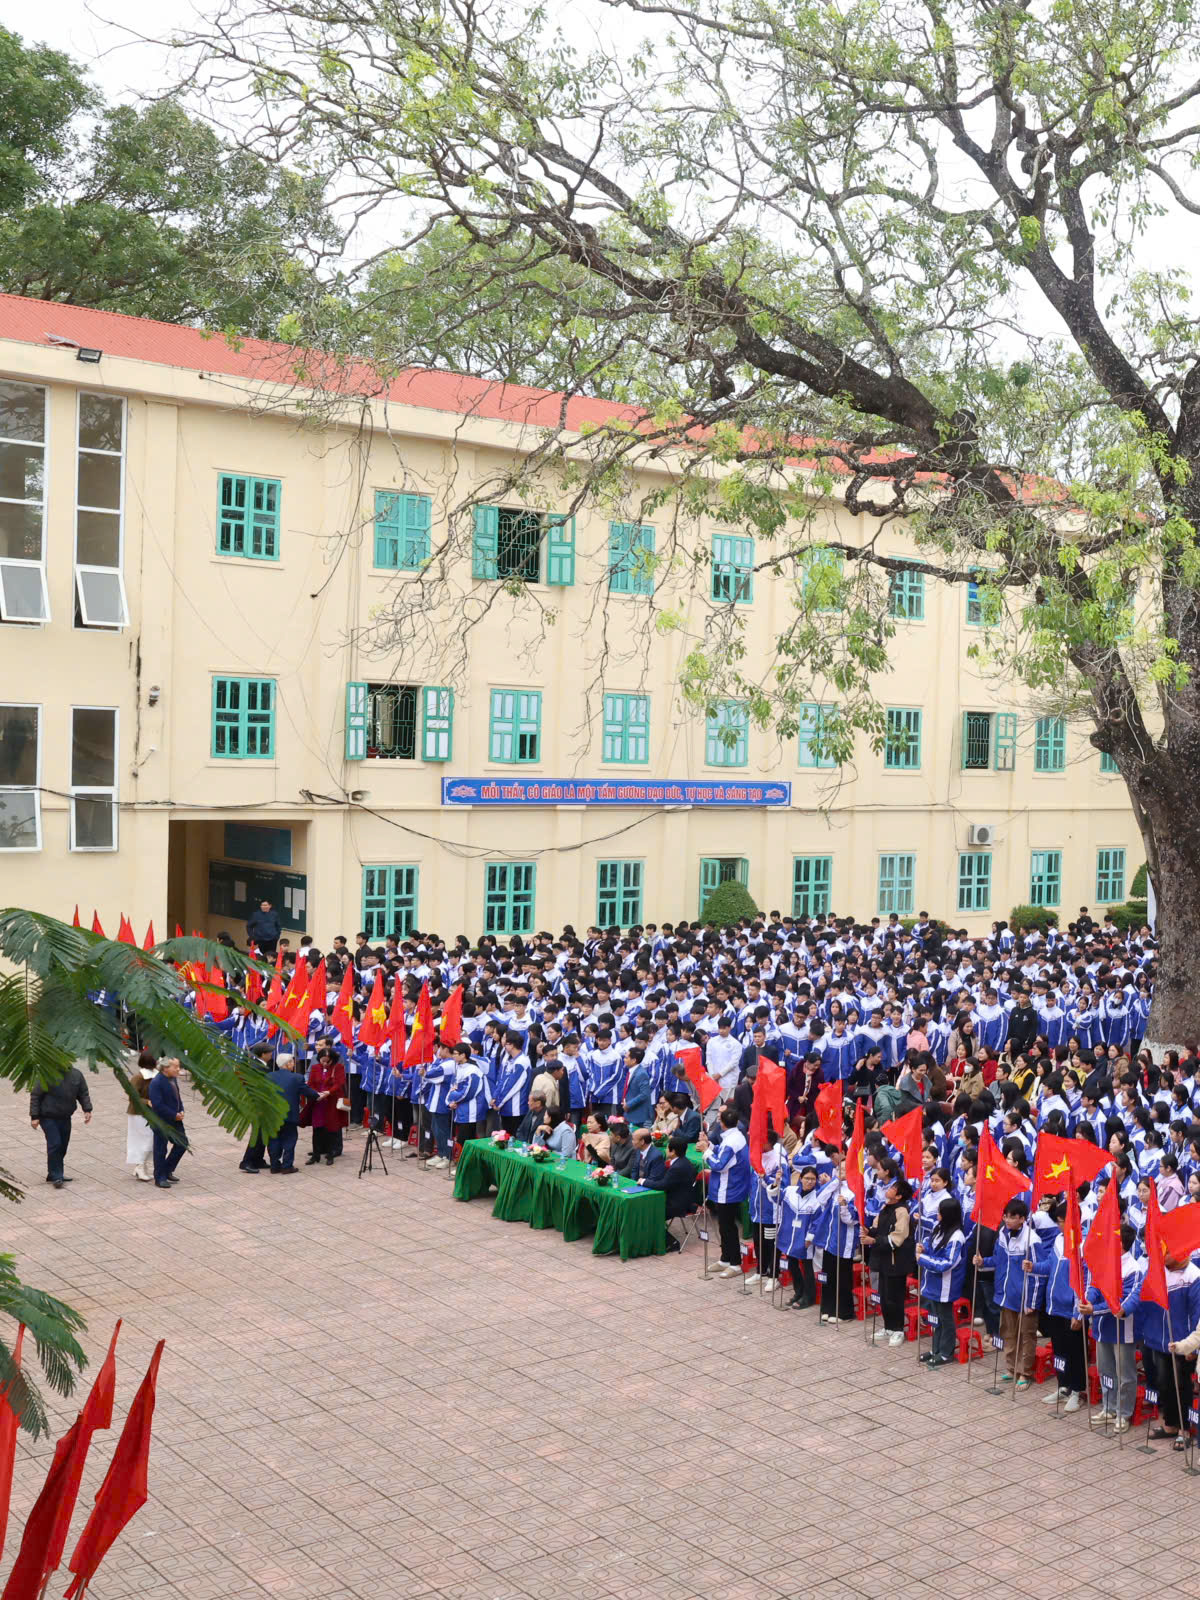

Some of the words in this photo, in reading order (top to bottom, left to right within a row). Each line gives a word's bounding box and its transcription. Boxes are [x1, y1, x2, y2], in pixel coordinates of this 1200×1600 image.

[481, 782, 500, 799] MỖI
[527, 784, 540, 799] CÔ
[541, 784, 563, 799] GIÁO
[564, 784, 576, 799] LÀ
[577, 784, 596, 801] MỘT
[597, 782, 616, 799] TẤM
[617, 785, 646, 800] GƯƠNG
[647, 787, 665, 802] ĐẠO
[685, 786, 696, 802] TỰ
[697, 787, 713, 802] HỌC
[713, 786, 725, 800] VÀ
[725, 785, 747, 801] SÁNG
[748, 787, 763, 802] TẠO
[1054, 1357, 1066, 1371] 11A2
